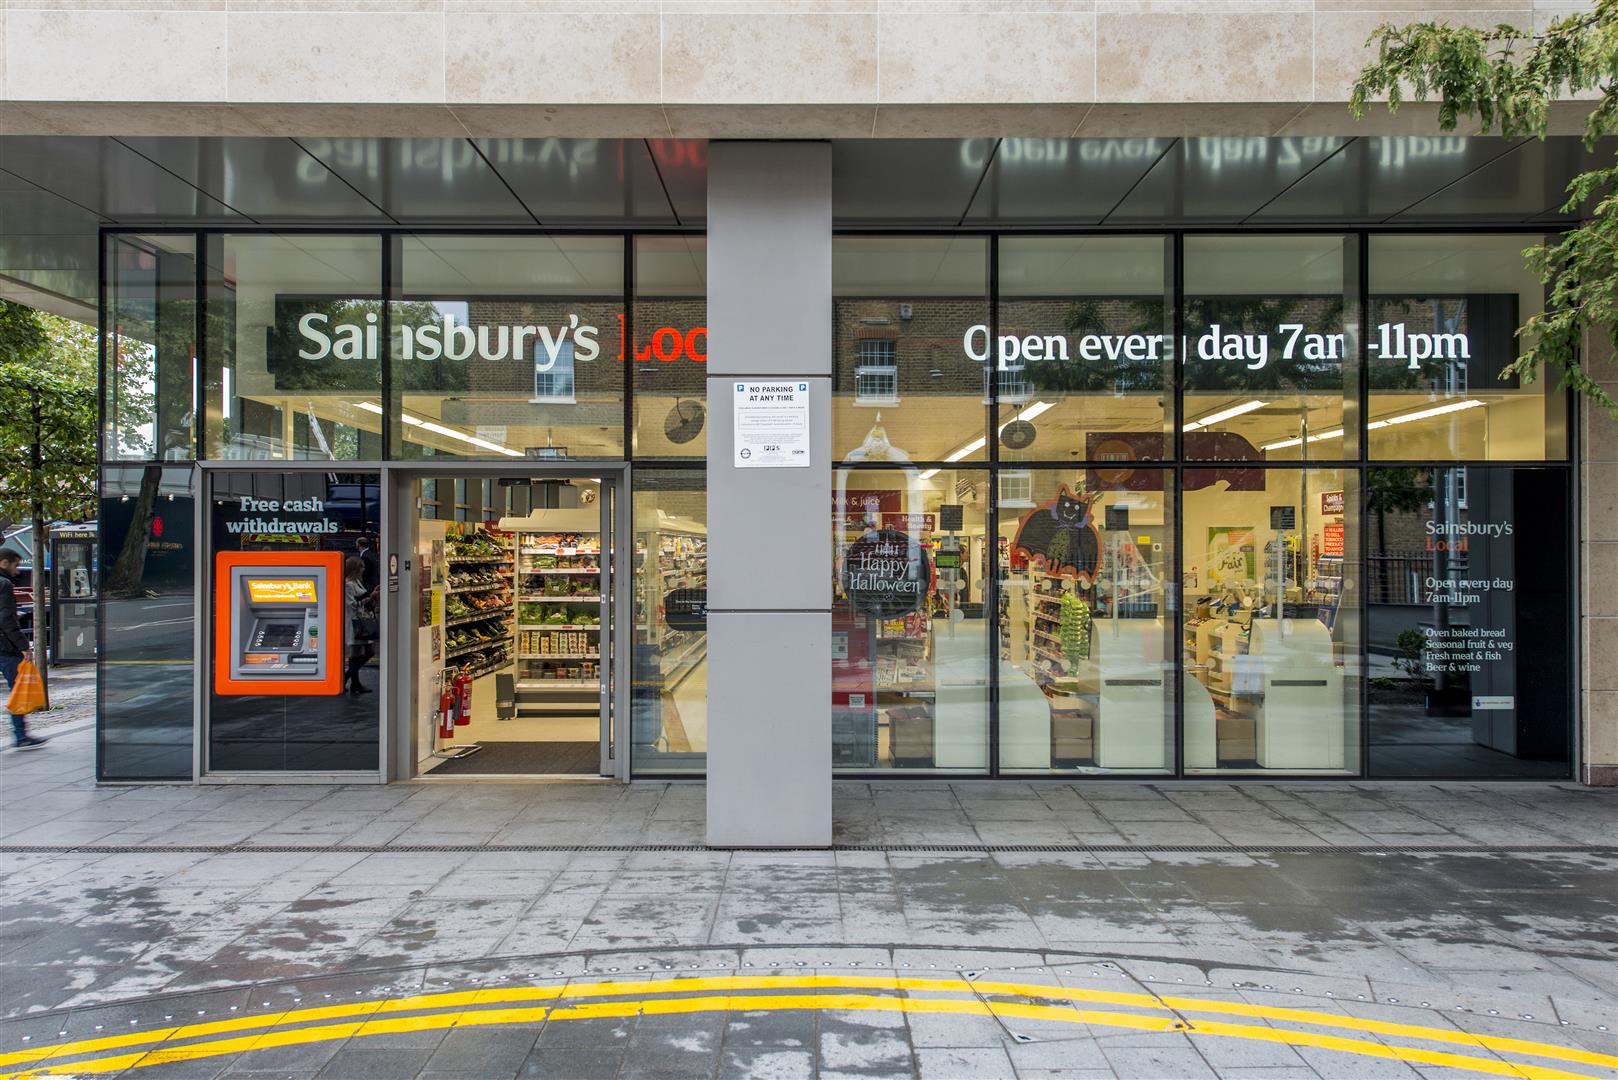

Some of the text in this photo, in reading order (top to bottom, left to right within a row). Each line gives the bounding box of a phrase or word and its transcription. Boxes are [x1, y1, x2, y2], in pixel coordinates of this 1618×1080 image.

[963, 324, 1069, 371] Open
[1198, 324, 1268, 370] day
[240, 496, 324, 512] Free cash
[851, 496, 858, 506] &
[226, 517, 338, 533] withdrawals
[1425, 520, 1513, 538] Sainsbury's
[860, 551, 910, 580] Happy
[850, 572, 921, 593] Halloween
[1425, 577, 1513, 591] Open every day
[1425, 592, 1480, 606] 7am-11pm
[1426, 628, 1505, 637] Oven baked bread
[1426, 640, 1513, 651] Seasonal fruit & veg
[1426, 651, 1501, 660] Fresh meat & fish
[1426, 663, 1481, 671] Beer & wine
